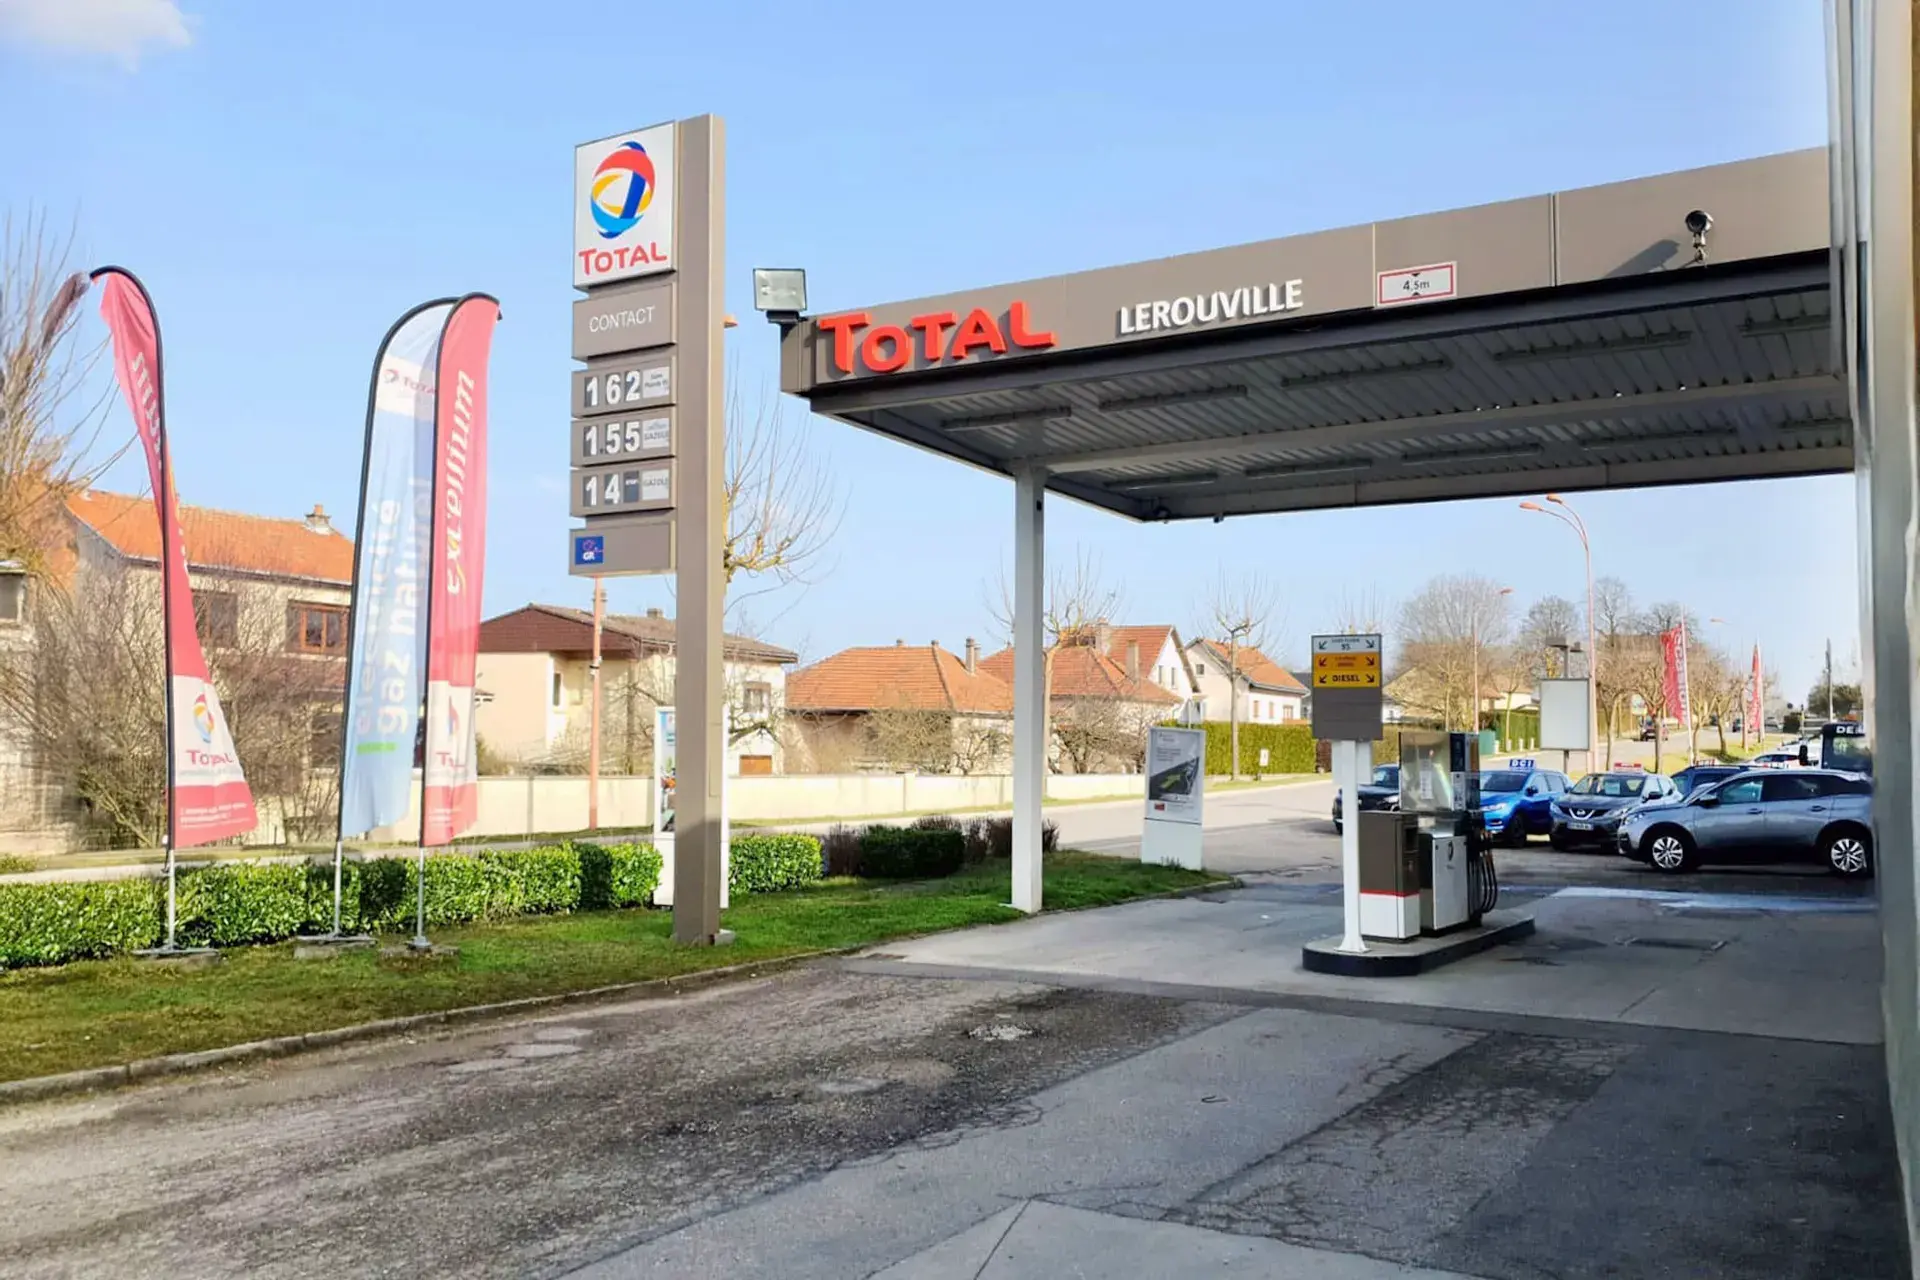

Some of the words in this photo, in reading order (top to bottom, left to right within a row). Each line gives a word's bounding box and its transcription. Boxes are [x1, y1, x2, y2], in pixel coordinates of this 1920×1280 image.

[578, 242, 668, 275] TOTAL
[589, 305, 655, 333] CONTACT
[1120, 279, 1304, 334] LEROUVILLE
[819, 299, 1056, 374] TOTAL
[377, 650, 411, 736] gaz
[1332, 674, 1361, 682] DIESEL
